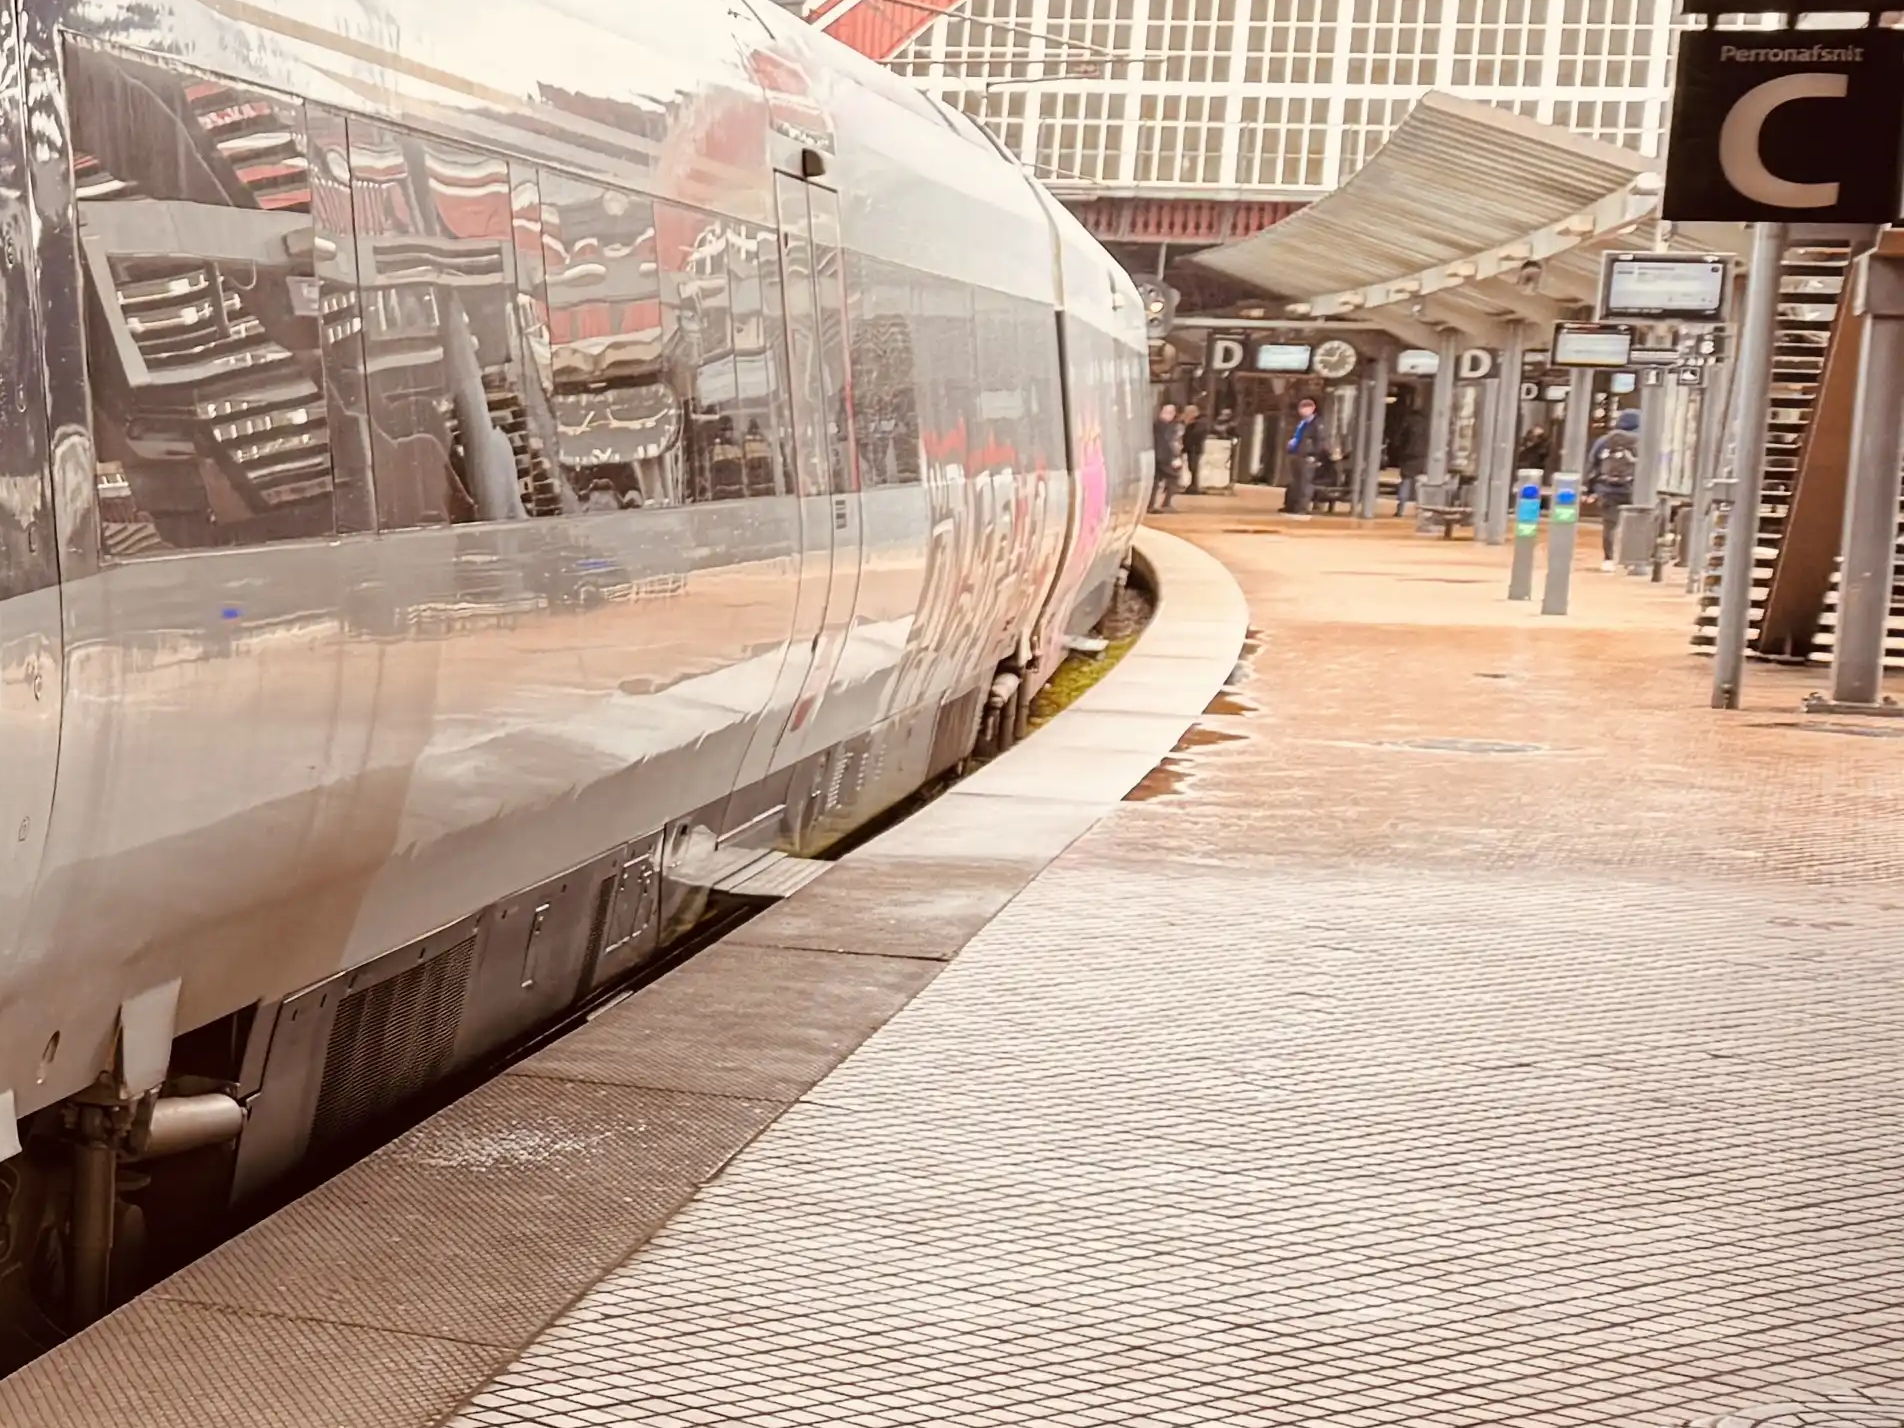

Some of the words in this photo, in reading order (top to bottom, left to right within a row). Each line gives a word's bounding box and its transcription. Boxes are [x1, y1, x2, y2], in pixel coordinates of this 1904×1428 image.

[1719, 43, 1865, 63] Perronafsnit
[1718, 72, 1849, 209] C
[1213, 339, 1244, 370] D
[1459, 348, 1492, 379] D
[1520, 382, 1539, 400] D
